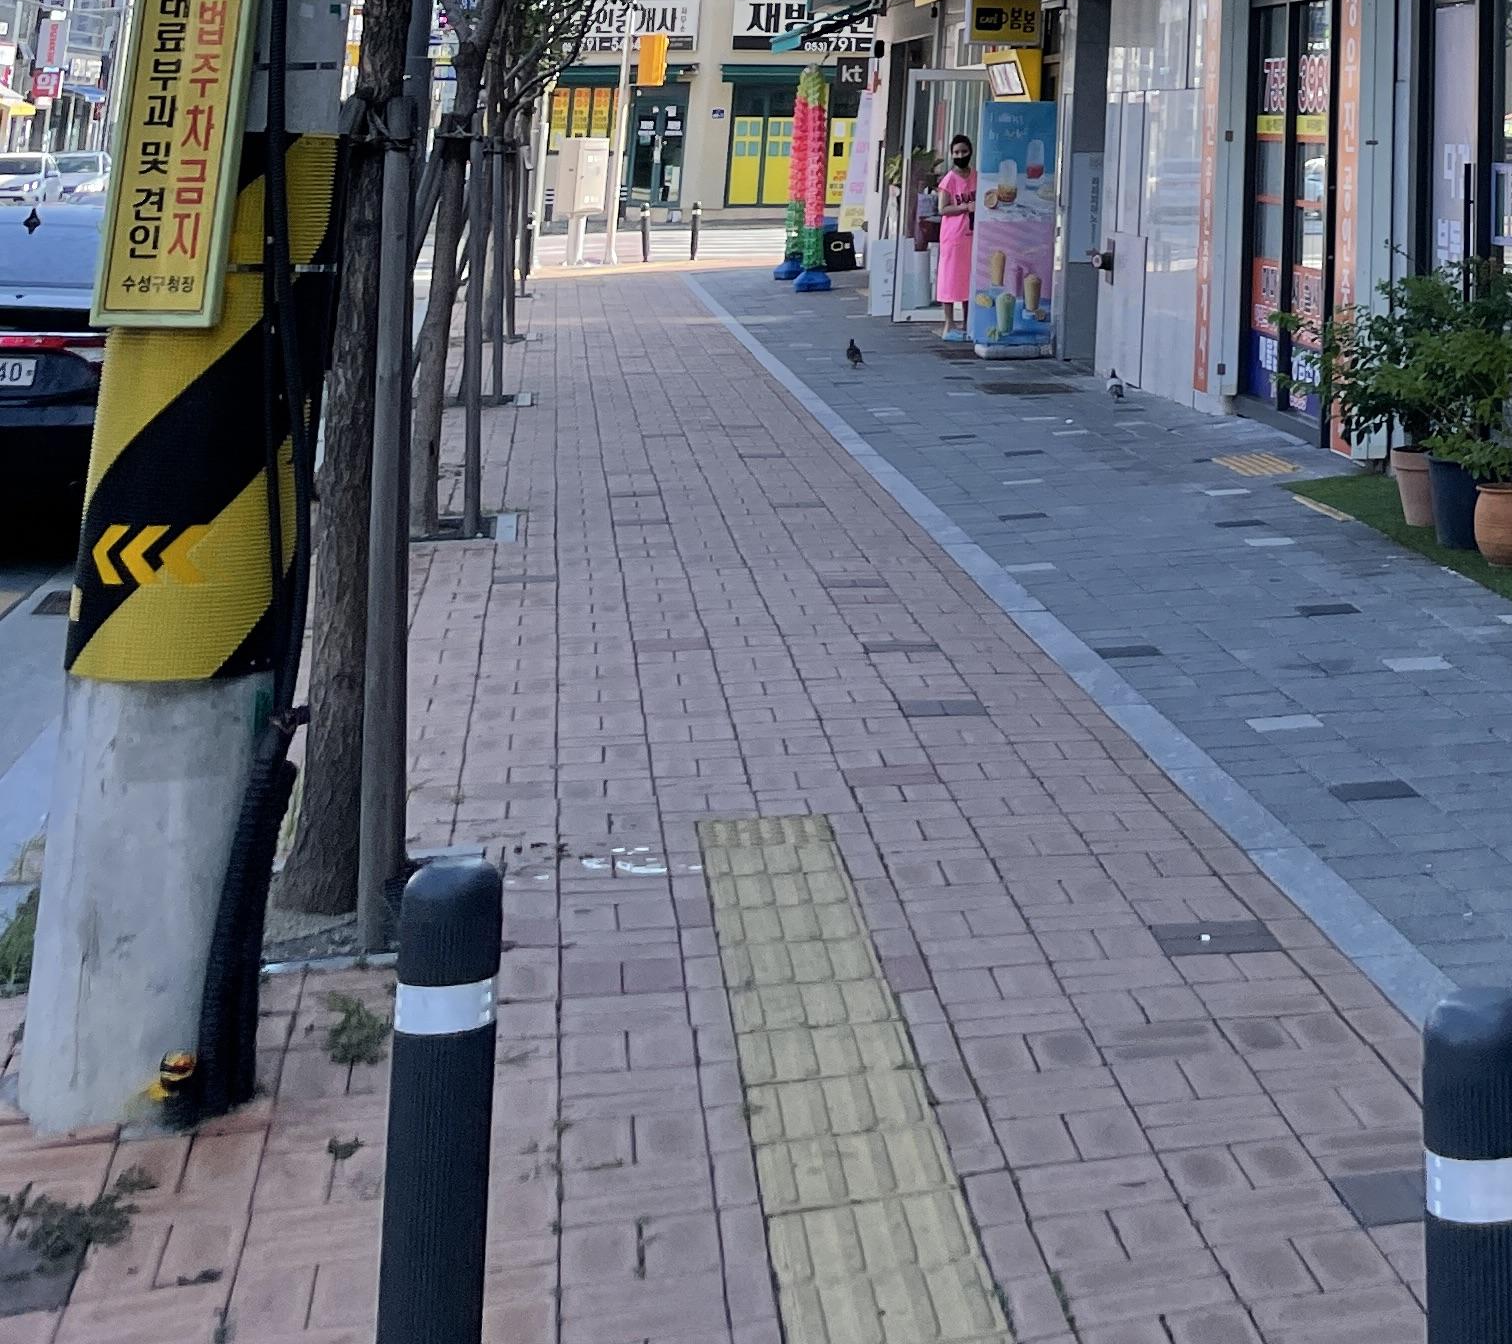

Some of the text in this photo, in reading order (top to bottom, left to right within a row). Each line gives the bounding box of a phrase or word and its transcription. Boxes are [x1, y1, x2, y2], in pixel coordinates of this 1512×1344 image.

[1010, 8, 1035, 34] 봄봄
[841, 64, 863, 83] kt
[138, 141, 169, 176] 및
[129, 187, 166, 260] 견인
[121, 273, 195, 295] 수성구청장
